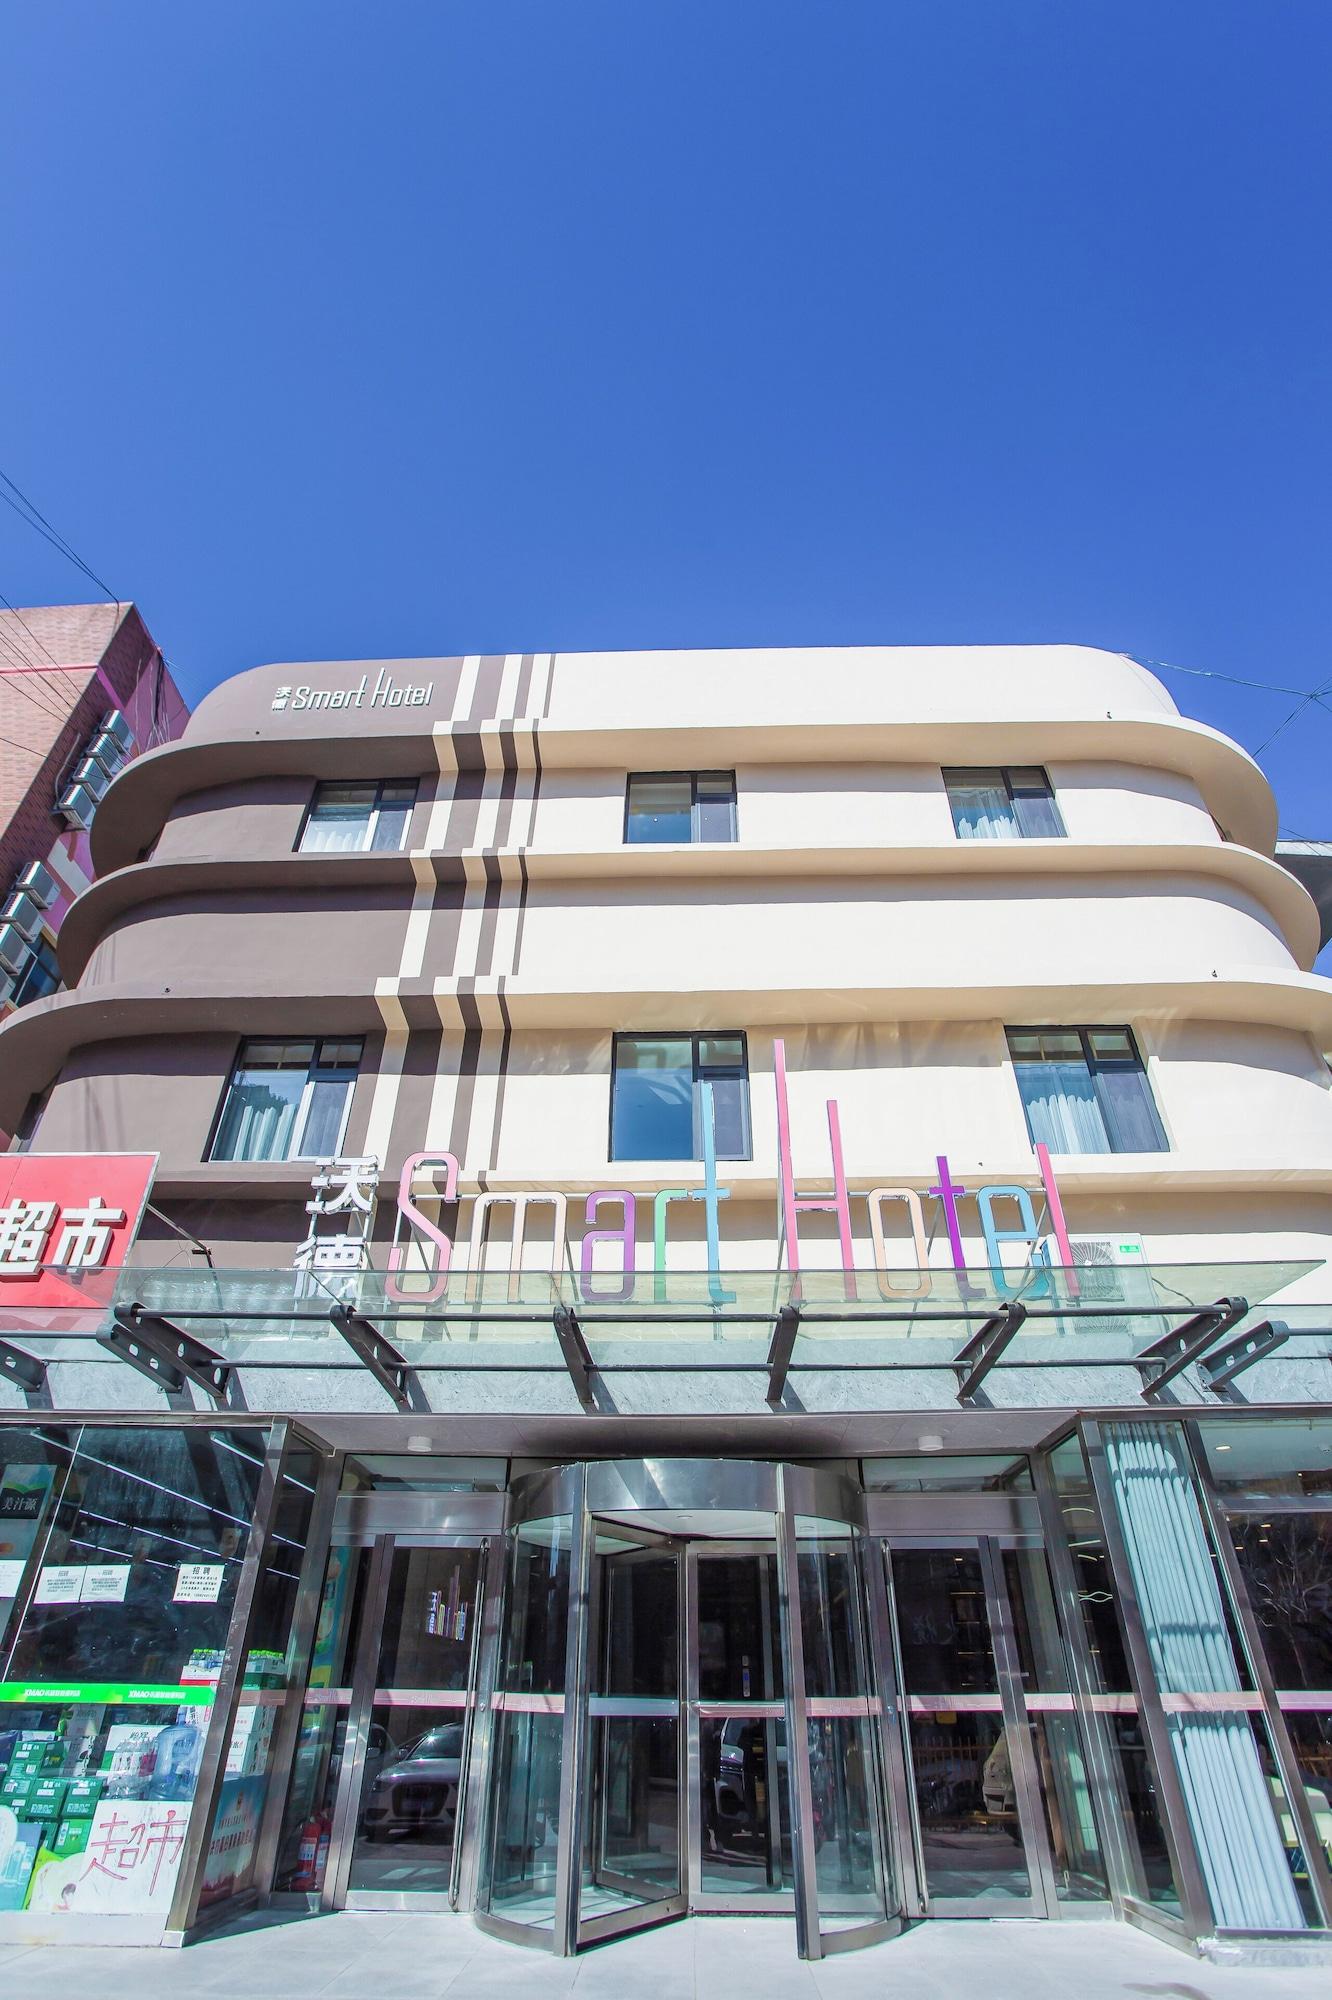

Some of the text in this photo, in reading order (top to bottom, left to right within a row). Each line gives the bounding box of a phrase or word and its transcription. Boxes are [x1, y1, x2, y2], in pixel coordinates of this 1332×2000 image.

[291, 667, 434, 710] Smart Hotel
[384, 1038, 1081, 1305] Smart Hotel
[0, 1196, 126, 1285] 超市
[79, 1809, 187, 1897] 超市
